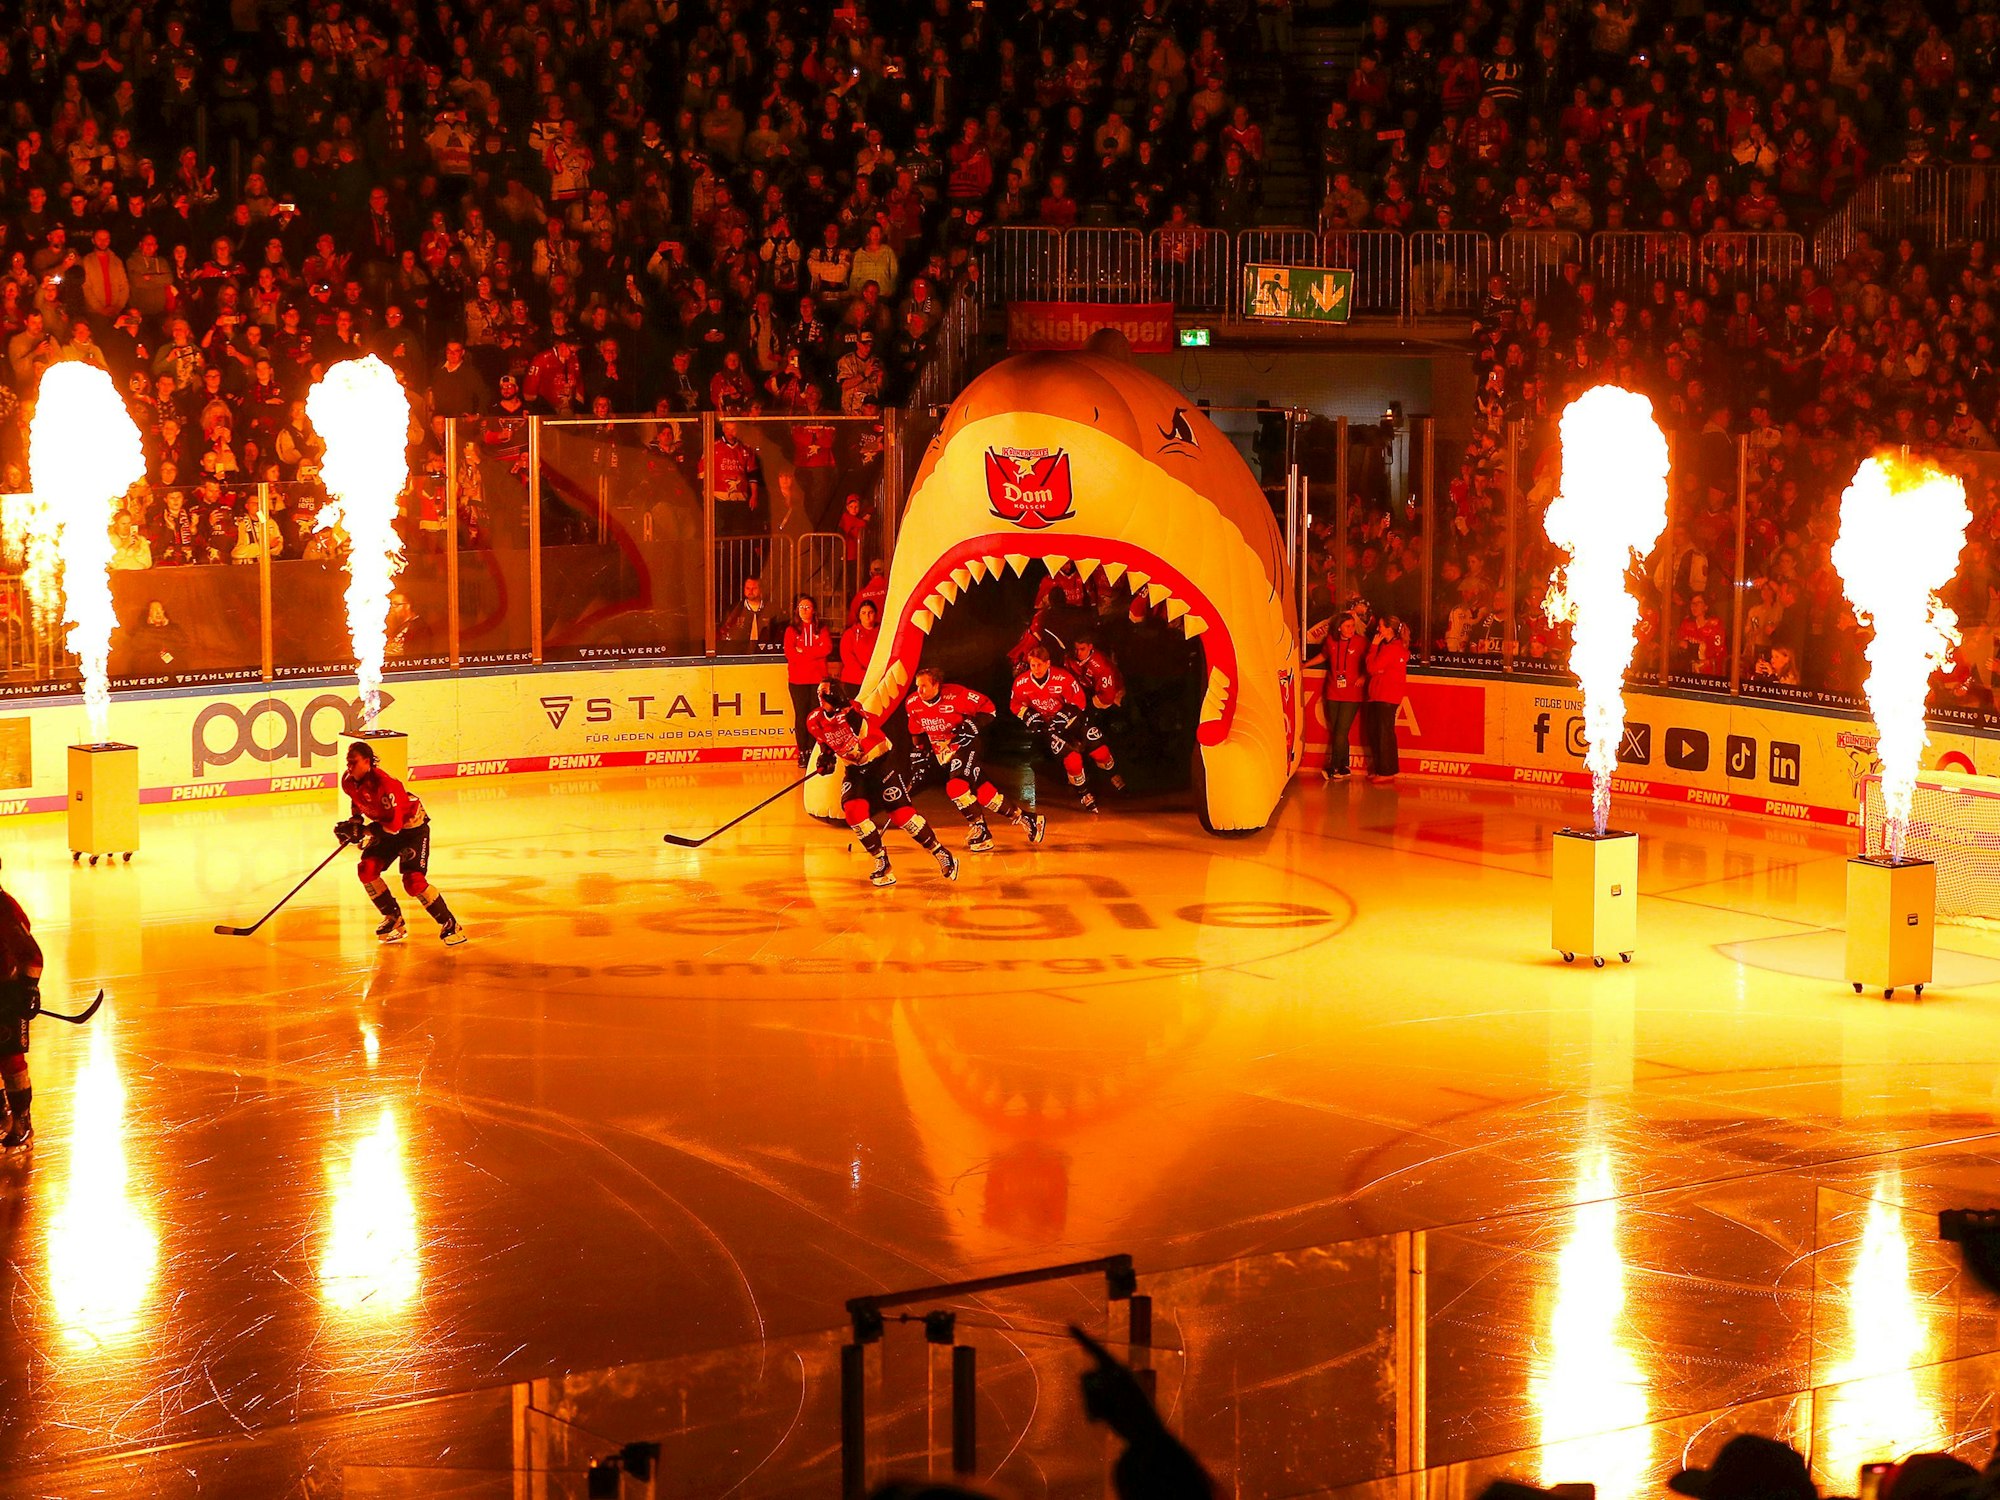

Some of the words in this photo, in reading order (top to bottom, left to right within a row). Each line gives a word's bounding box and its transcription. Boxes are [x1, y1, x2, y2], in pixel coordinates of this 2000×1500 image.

[1002, 482, 1053, 503] Dom
[384, 657, 445, 668] TAHLWERK
[1512, 660, 1565, 672] STAHLWE
[1101, 675, 1113, 689] 34
[586, 691, 785, 723] STAHL
[1534, 697, 1562, 709] FOLGE
[1564, 699, 1583, 711] UNS
[586, 732, 609, 743] FÜR
[614, 731, 655, 742] JEDEN
[659, 730, 683, 740] JOB
[688, 730, 713, 739] DAS
[717, 727, 785, 737] PASSENDE
[824, 727, 850, 741] Rhein
[382, 792, 397, 810] 92
